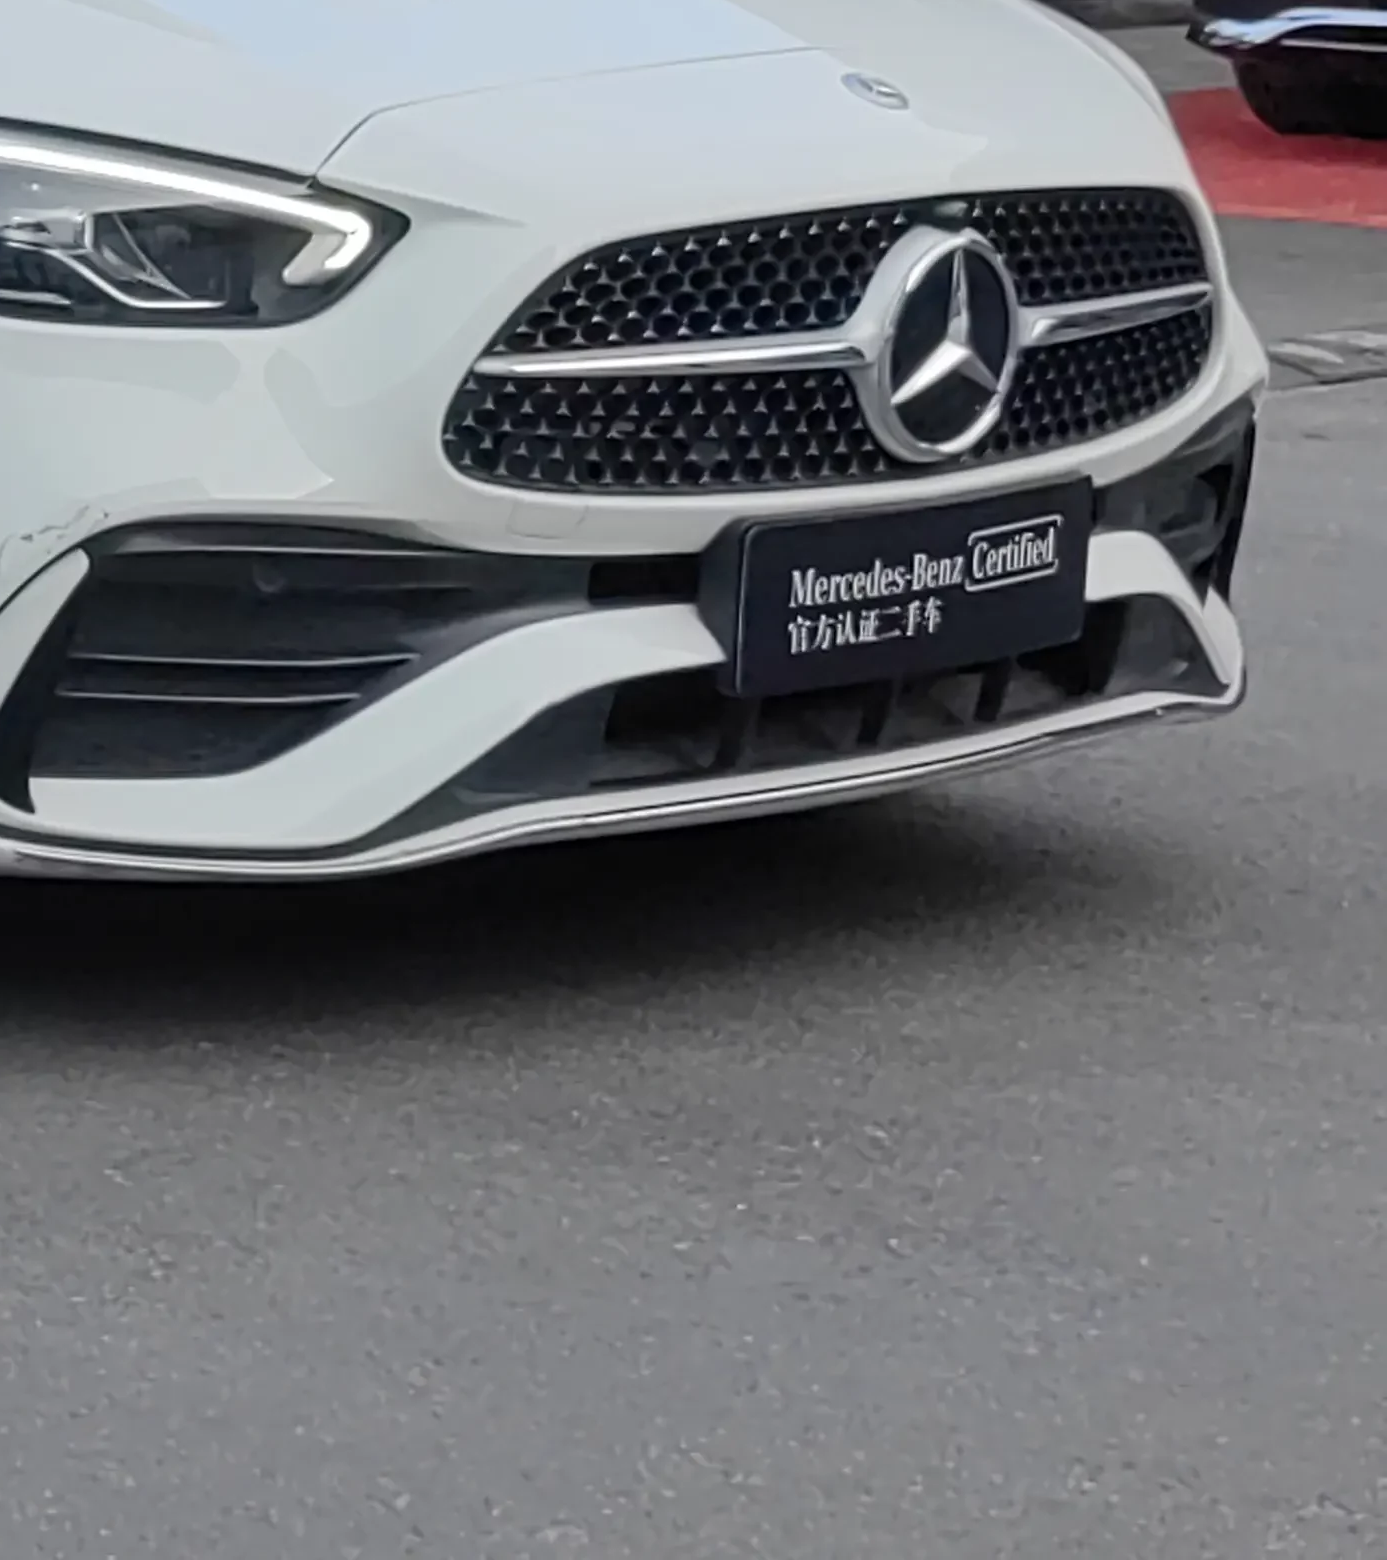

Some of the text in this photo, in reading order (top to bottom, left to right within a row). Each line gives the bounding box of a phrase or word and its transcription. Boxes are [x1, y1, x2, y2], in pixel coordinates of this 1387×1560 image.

[788, 527, 1055, 607] Mercedes-Benz Certified
[787, 596, 943, 654] 官方认证二手车
